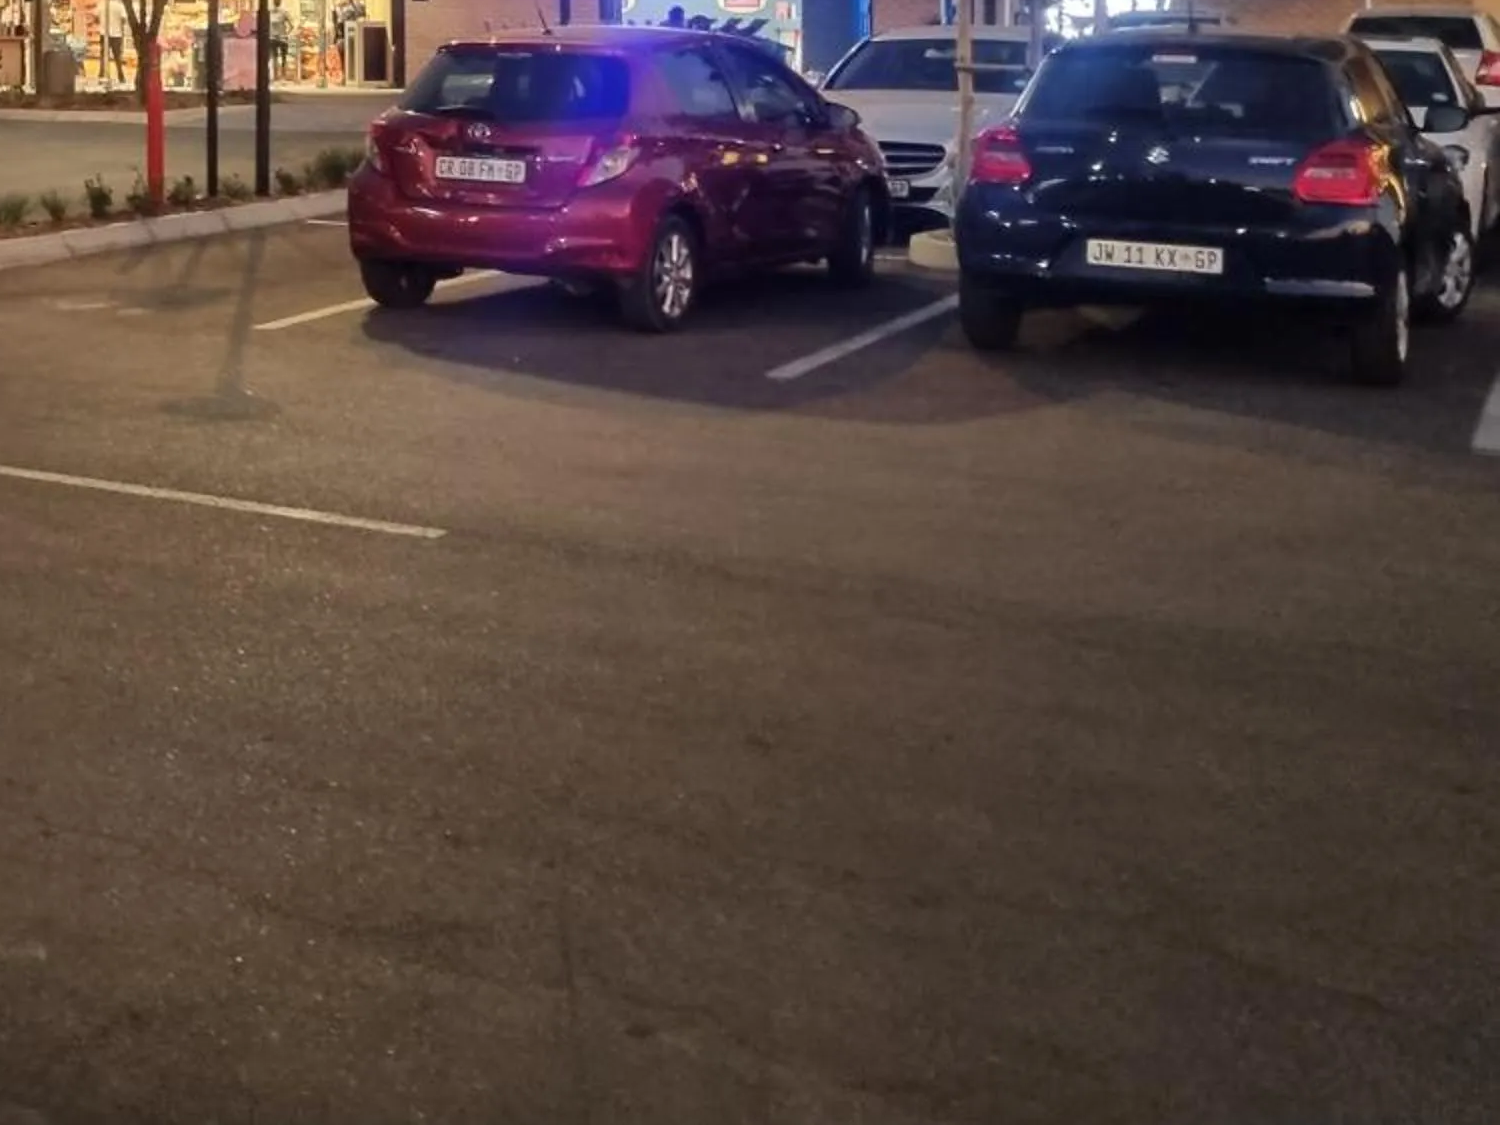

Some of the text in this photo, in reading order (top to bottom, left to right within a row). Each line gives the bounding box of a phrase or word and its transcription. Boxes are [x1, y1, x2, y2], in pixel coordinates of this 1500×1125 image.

[1093, 242, 1217, 269] JW 11 KX GP
